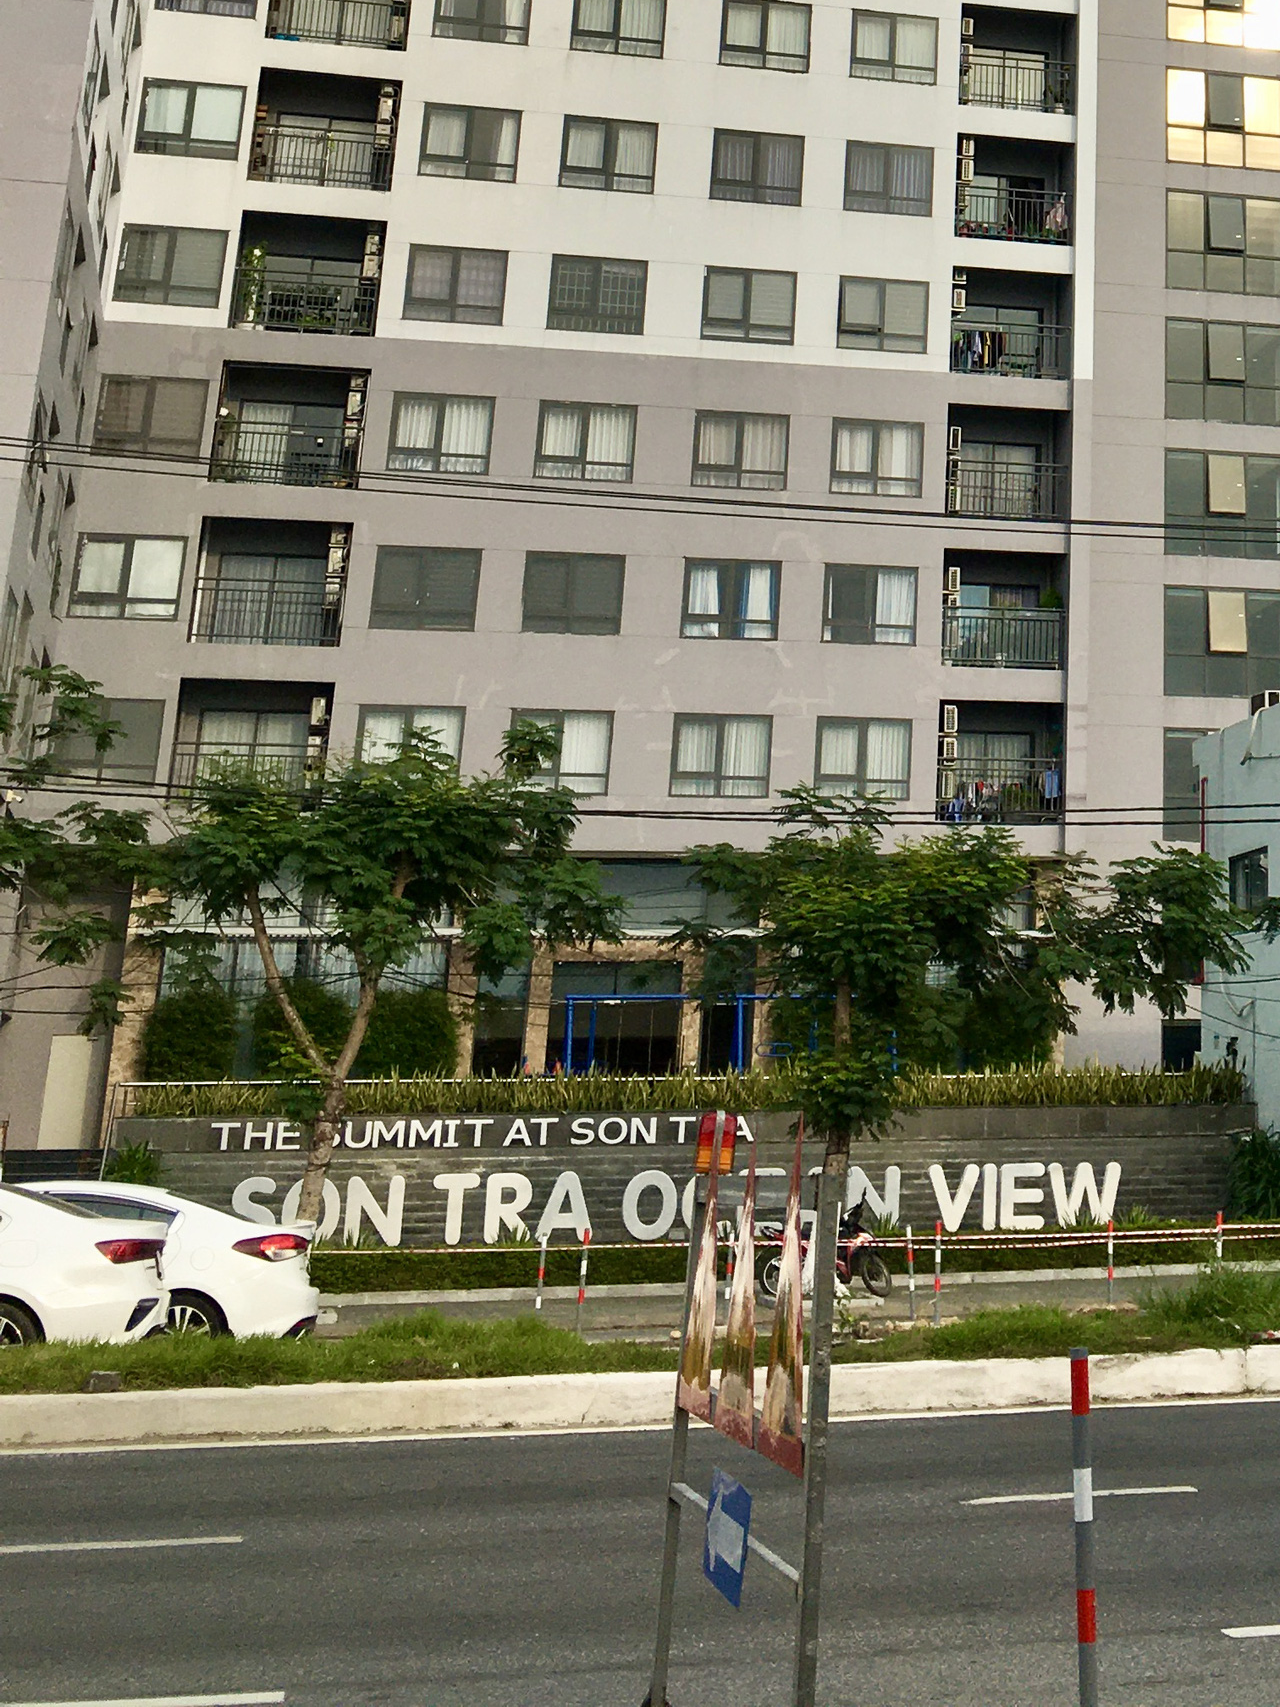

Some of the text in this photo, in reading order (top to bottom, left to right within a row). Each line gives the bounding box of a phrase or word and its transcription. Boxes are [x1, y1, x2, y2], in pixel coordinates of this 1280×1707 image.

[211, 1116, 754, 1151] THE UMMIT AT SON TA
[232, 1175, 406, 1247] SON
[433, 1171, 592, 1245] TRA
[928, 1162, 1122, 1233] VIEW
